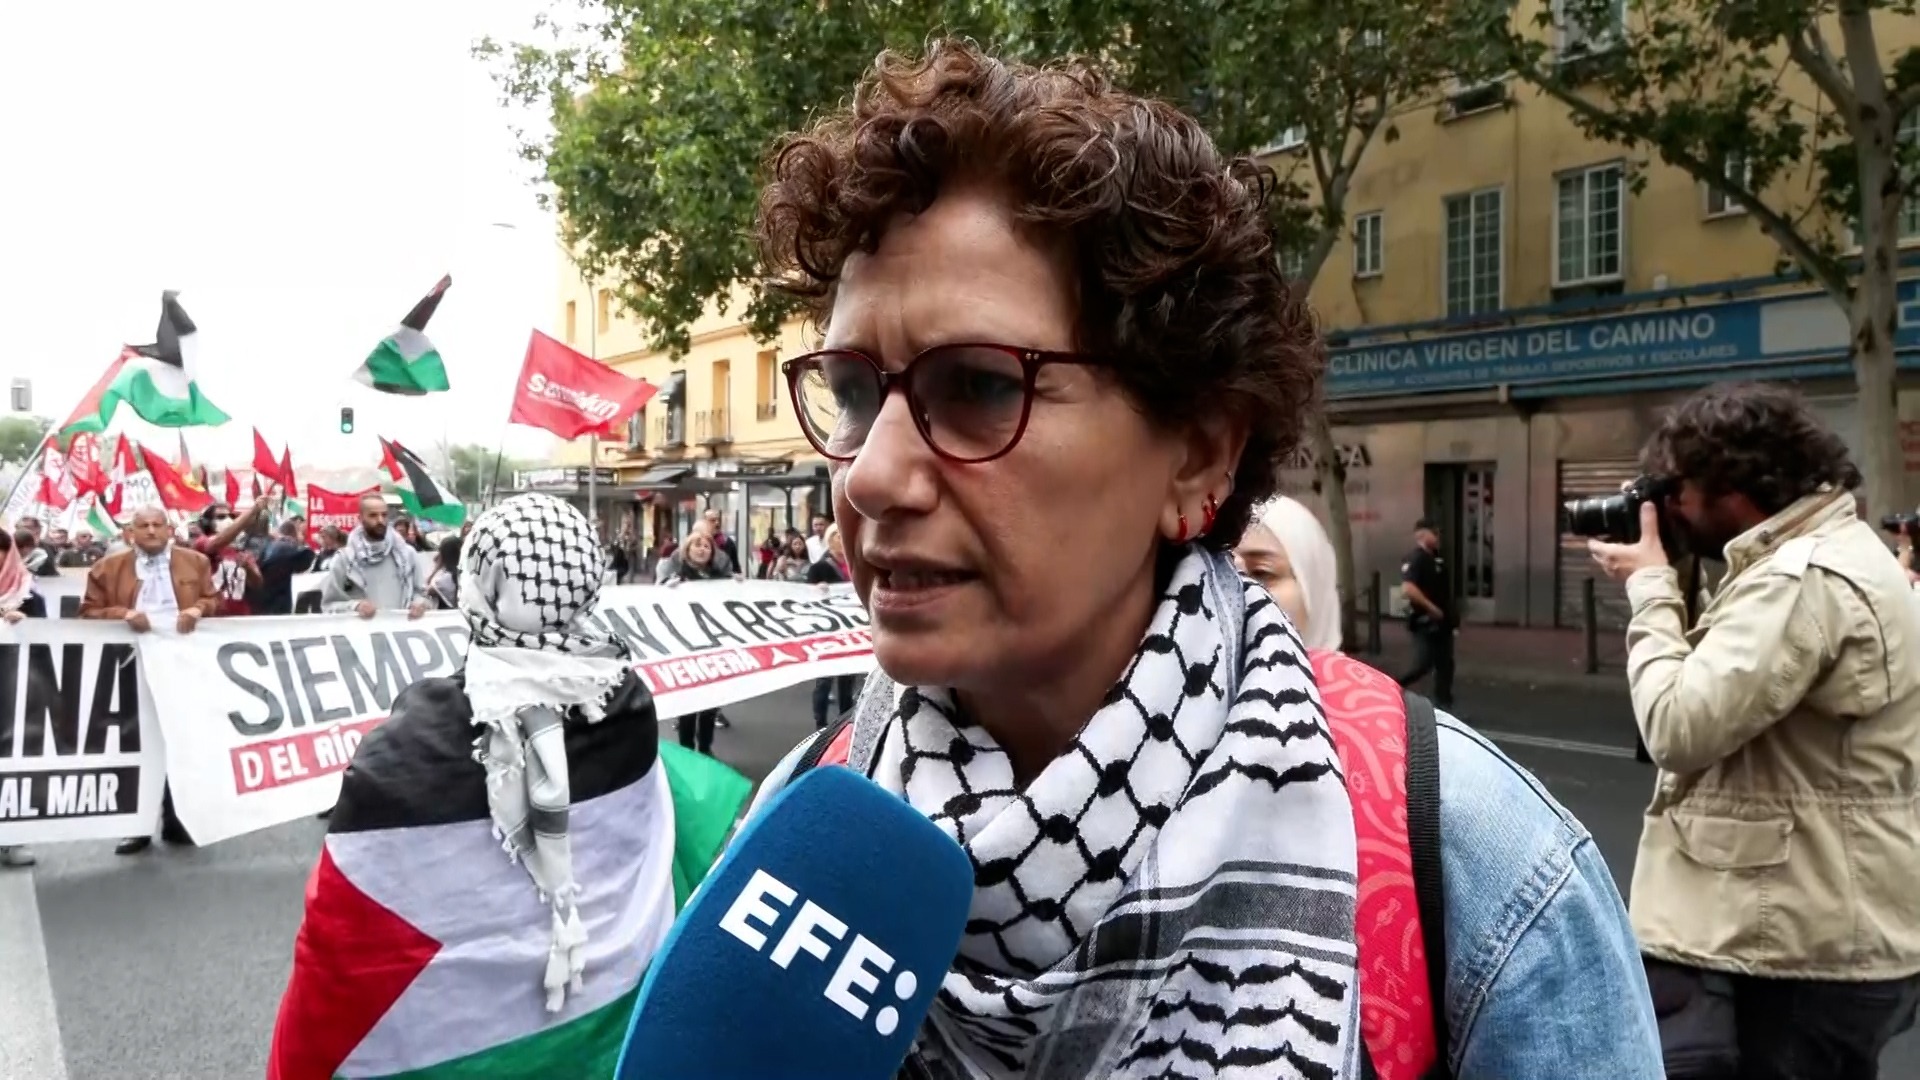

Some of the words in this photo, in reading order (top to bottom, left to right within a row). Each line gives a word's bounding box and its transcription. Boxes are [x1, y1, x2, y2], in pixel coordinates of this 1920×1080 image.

[1424, 336, 1518, 366] VIRGEN
[1527, 329, 1581, 355] DEL
[1589, 313, 1716, 349] CAMINO
[652, 602, 747, 651] LA
[0, 777, 39, 818] AL
[47, 773, 119, 816] MAR
